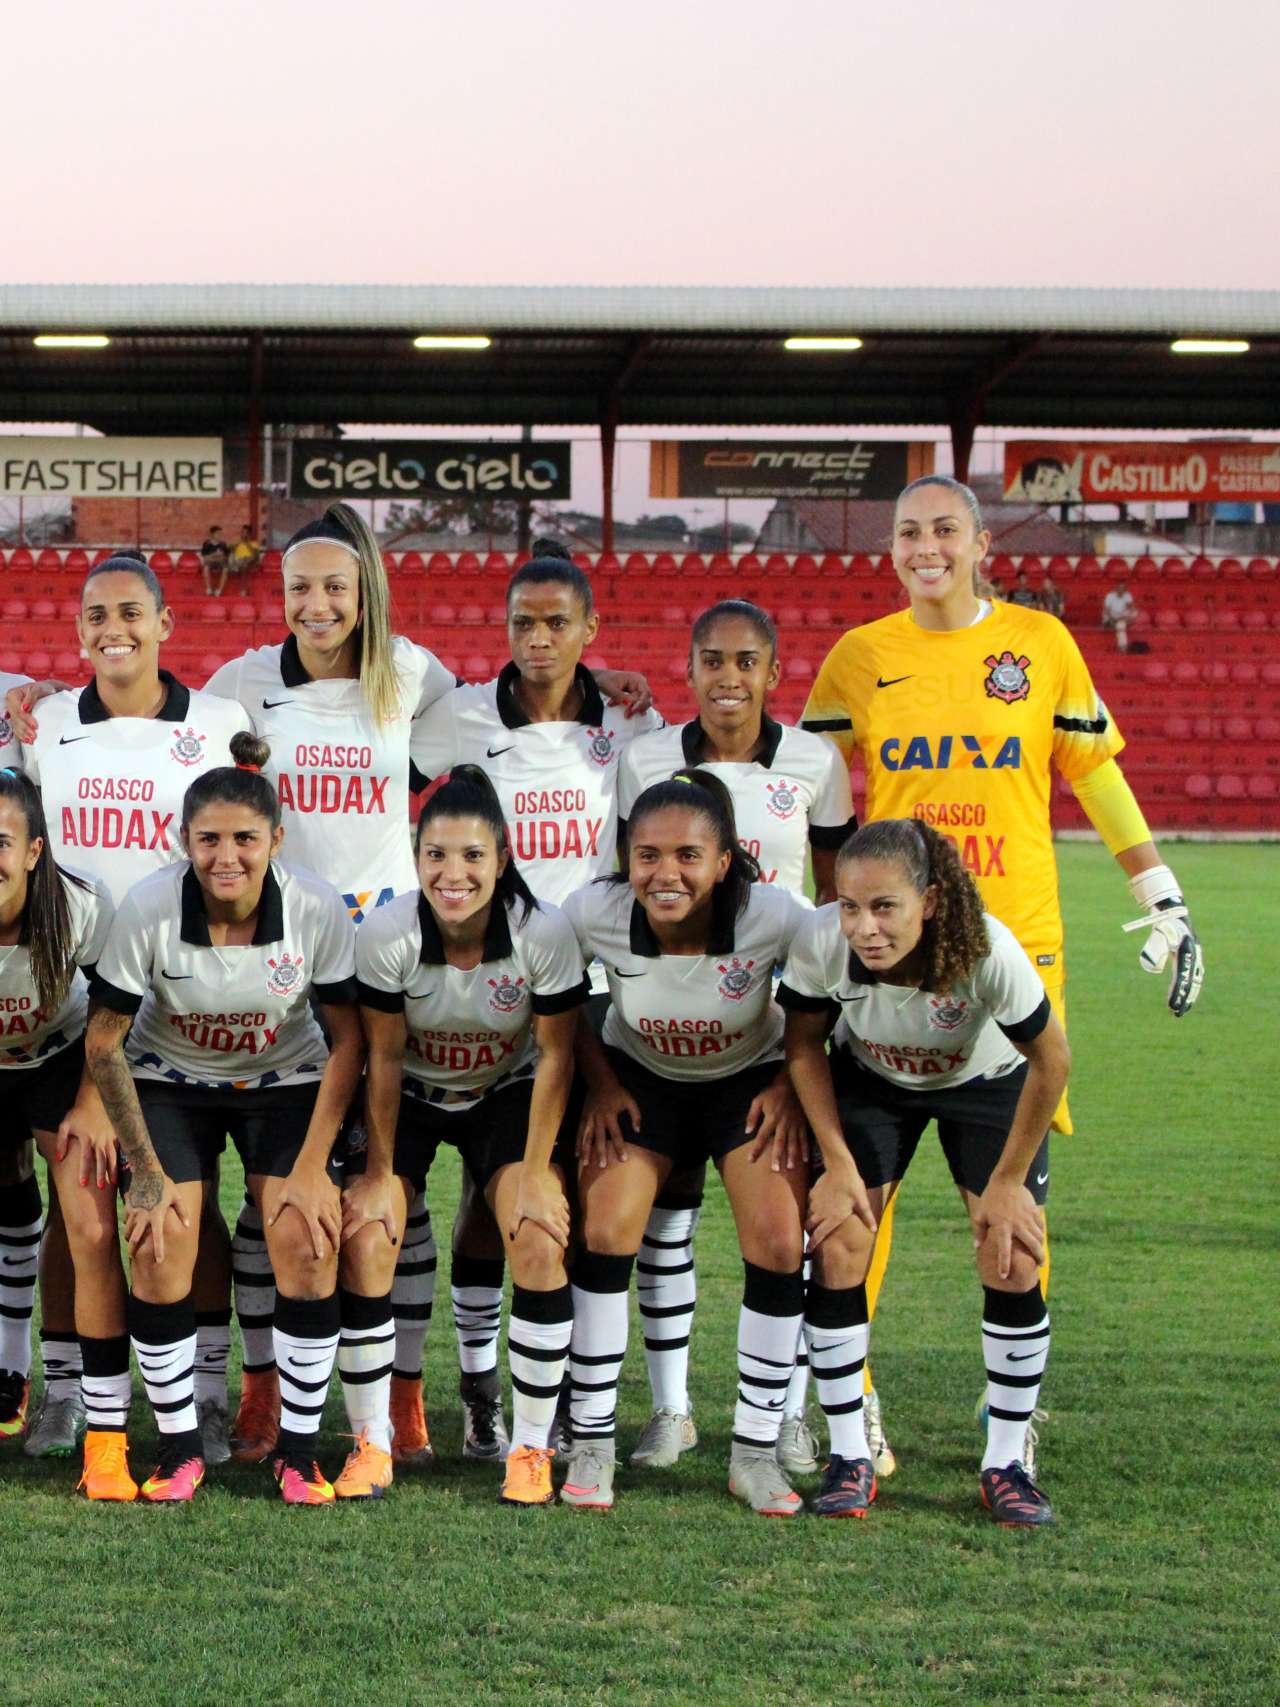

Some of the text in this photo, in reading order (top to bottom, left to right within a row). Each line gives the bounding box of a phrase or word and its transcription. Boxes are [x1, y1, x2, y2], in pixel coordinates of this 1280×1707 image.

[704, 444, 875, 468] connect
[4, 460, 218, 491] FASTSHARE
[304, 452, 558, 490] cielo cielo
[296, 744, 372, 769] OSASCO
[880, 735, 1021, 771] CAIXA
[78, 777, 155, 802] OSASCO
[278, 773, 391, 815] AUDAX
[515, 789, 586, 815] OSASCO
[913, 802, 986, 827] OSASCO
[61, 806, 175, 852] AUDAX
[189, 1012, 266, 1026] OSASCO
[639, 1018, 723, 1034] OSASCO
[423, 1030, 502, 1044] OSASCO
[405, 1033, 518, 1072] AUDAX
